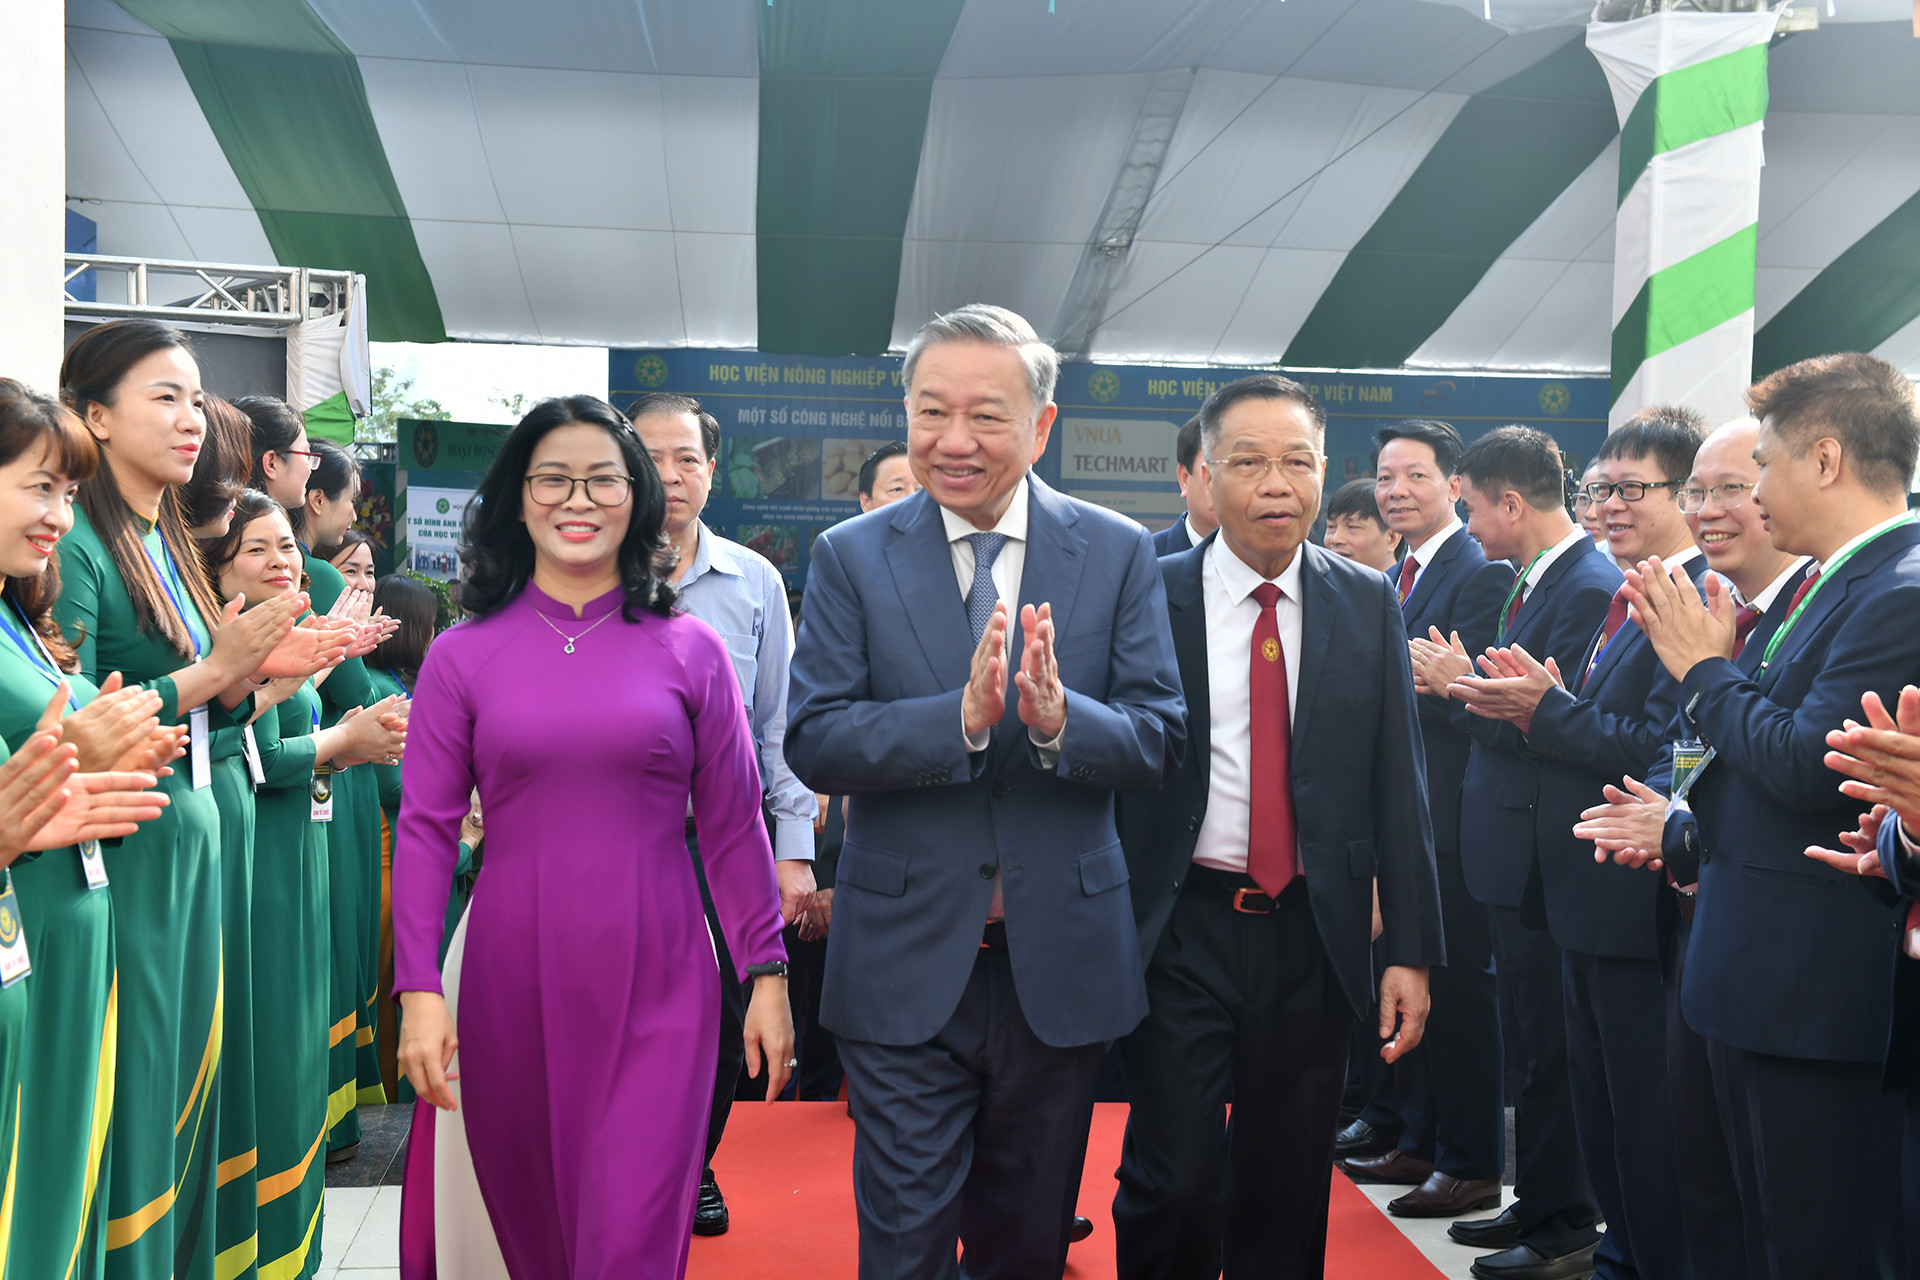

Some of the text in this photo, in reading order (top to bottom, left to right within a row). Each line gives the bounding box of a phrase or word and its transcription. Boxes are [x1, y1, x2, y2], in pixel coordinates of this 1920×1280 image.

[709, 364, 740, 385] HỌC
[744, 363, 779, 386] VIỆN
[784, 365, 826, 385] NÔNG
[831, 366, 887, 390] NGHIỆP
[1147, 379, 1178, 399] HỌC
[1324, 381, 1355, 405] VIỆT
[1358, 386, 1393, 403] NAM
[738, 406, 766, 426] MỘT
[770, 405, 788, 425] SỐ
[791, 408, 827, 426] CÔNG
[831, 410, 866, 430] NGHỆ
[869, 409, 892, 428] NỔI
[1074, 425, 1123, 445] VNUA
[1073, 454, 1169, 474] TECHMART
[424, 518, 442, 527] HÌNH
[434, 530, 449, 539] HỌC
